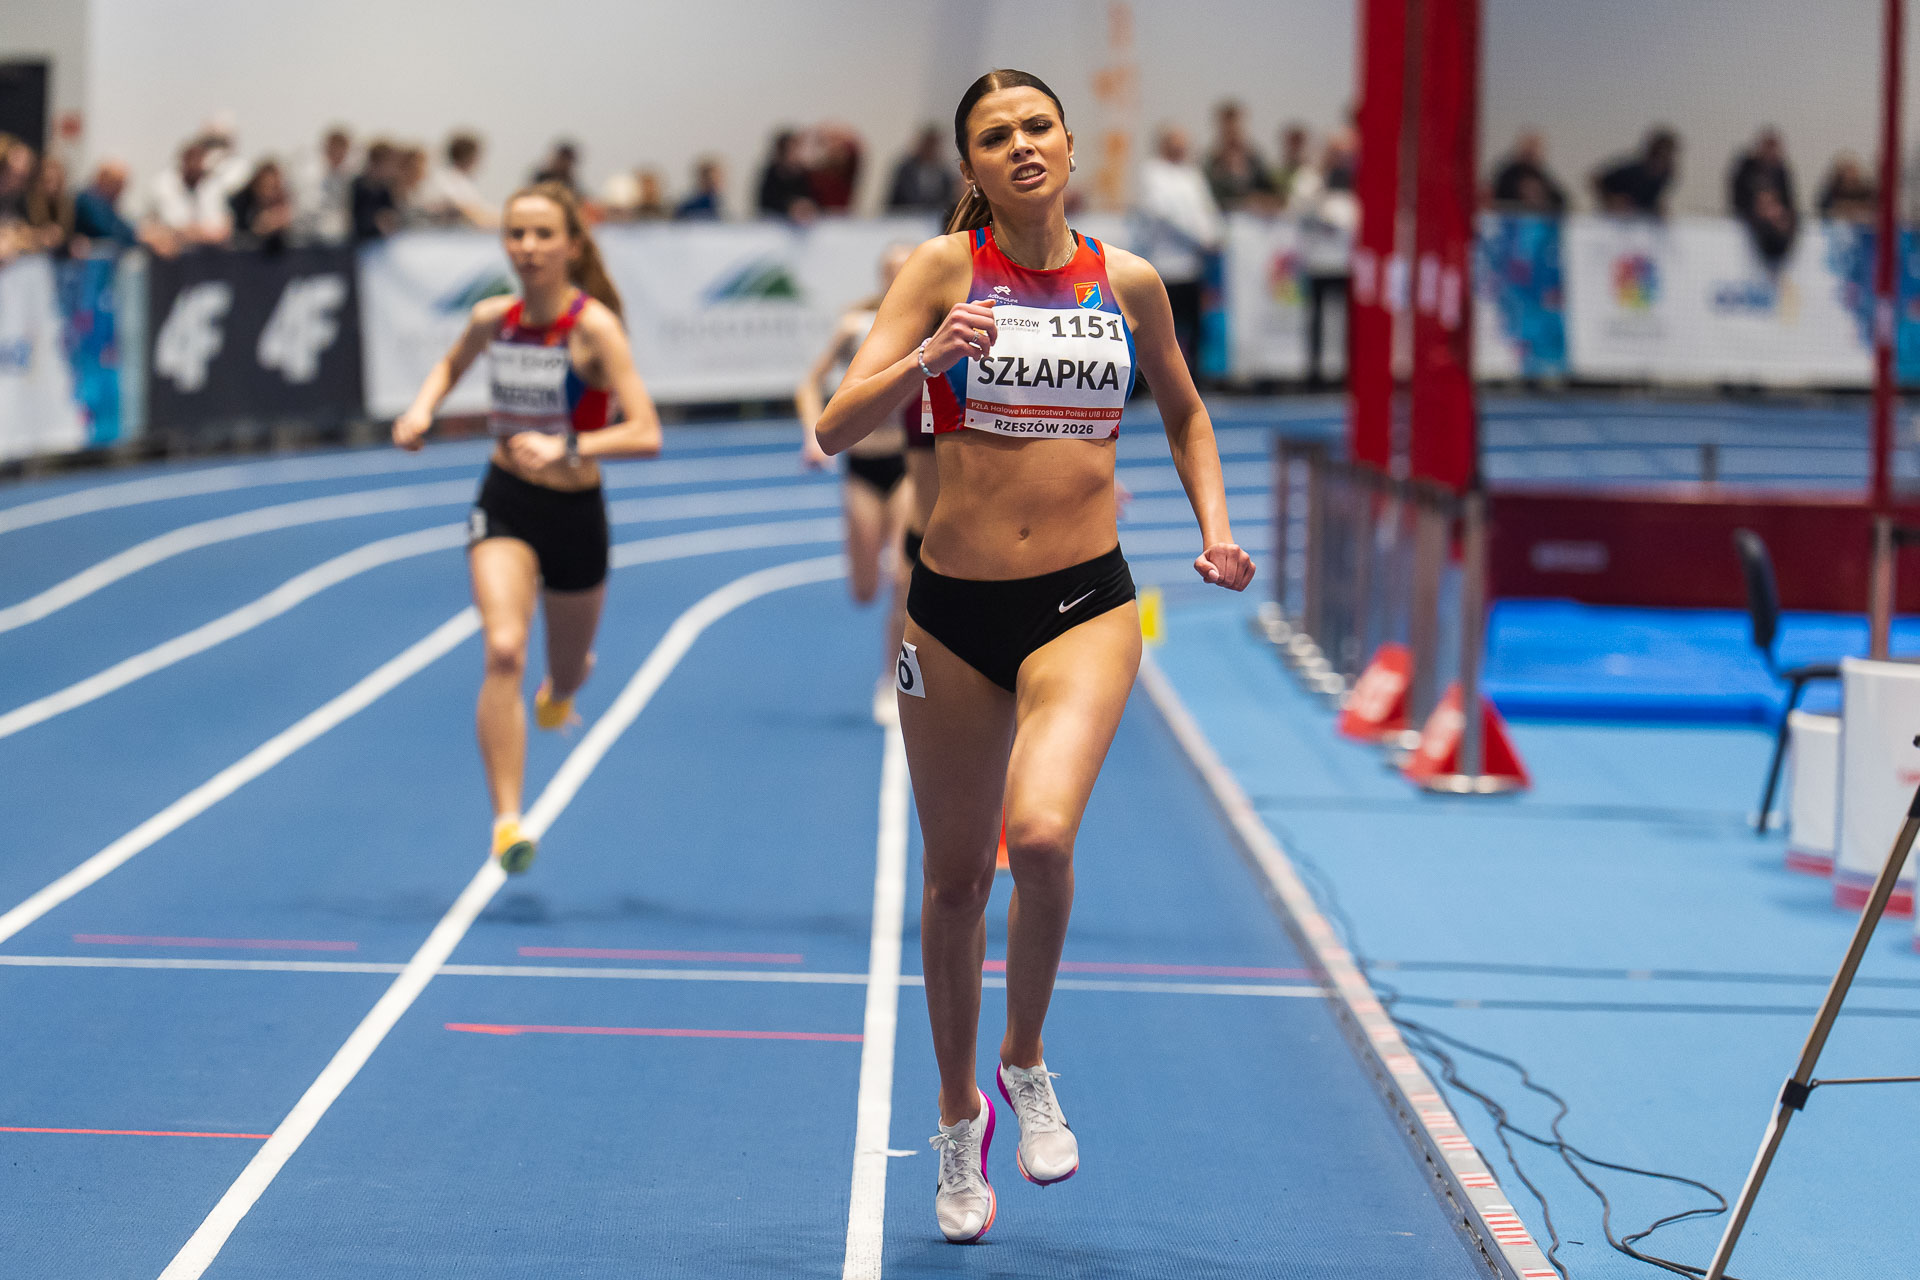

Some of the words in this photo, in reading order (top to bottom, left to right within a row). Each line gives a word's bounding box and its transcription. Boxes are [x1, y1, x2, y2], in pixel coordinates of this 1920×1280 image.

[1048, 315, 1123, 342] 1151
[977, 356, 1120, 391] SZŁAPKA
[990, 405, 1019, 415] Halowe
[1020, 408, 1064, 417] Mistrzostwa
[1065, 409, 1087, 418] Polski
[1088, 410, 1101, 418] U18
[1106, 410, 1120, 418] U20
[994, 419, 1059, 434] RZESZÓW
[1061, 423, 1094, 435] 2026
